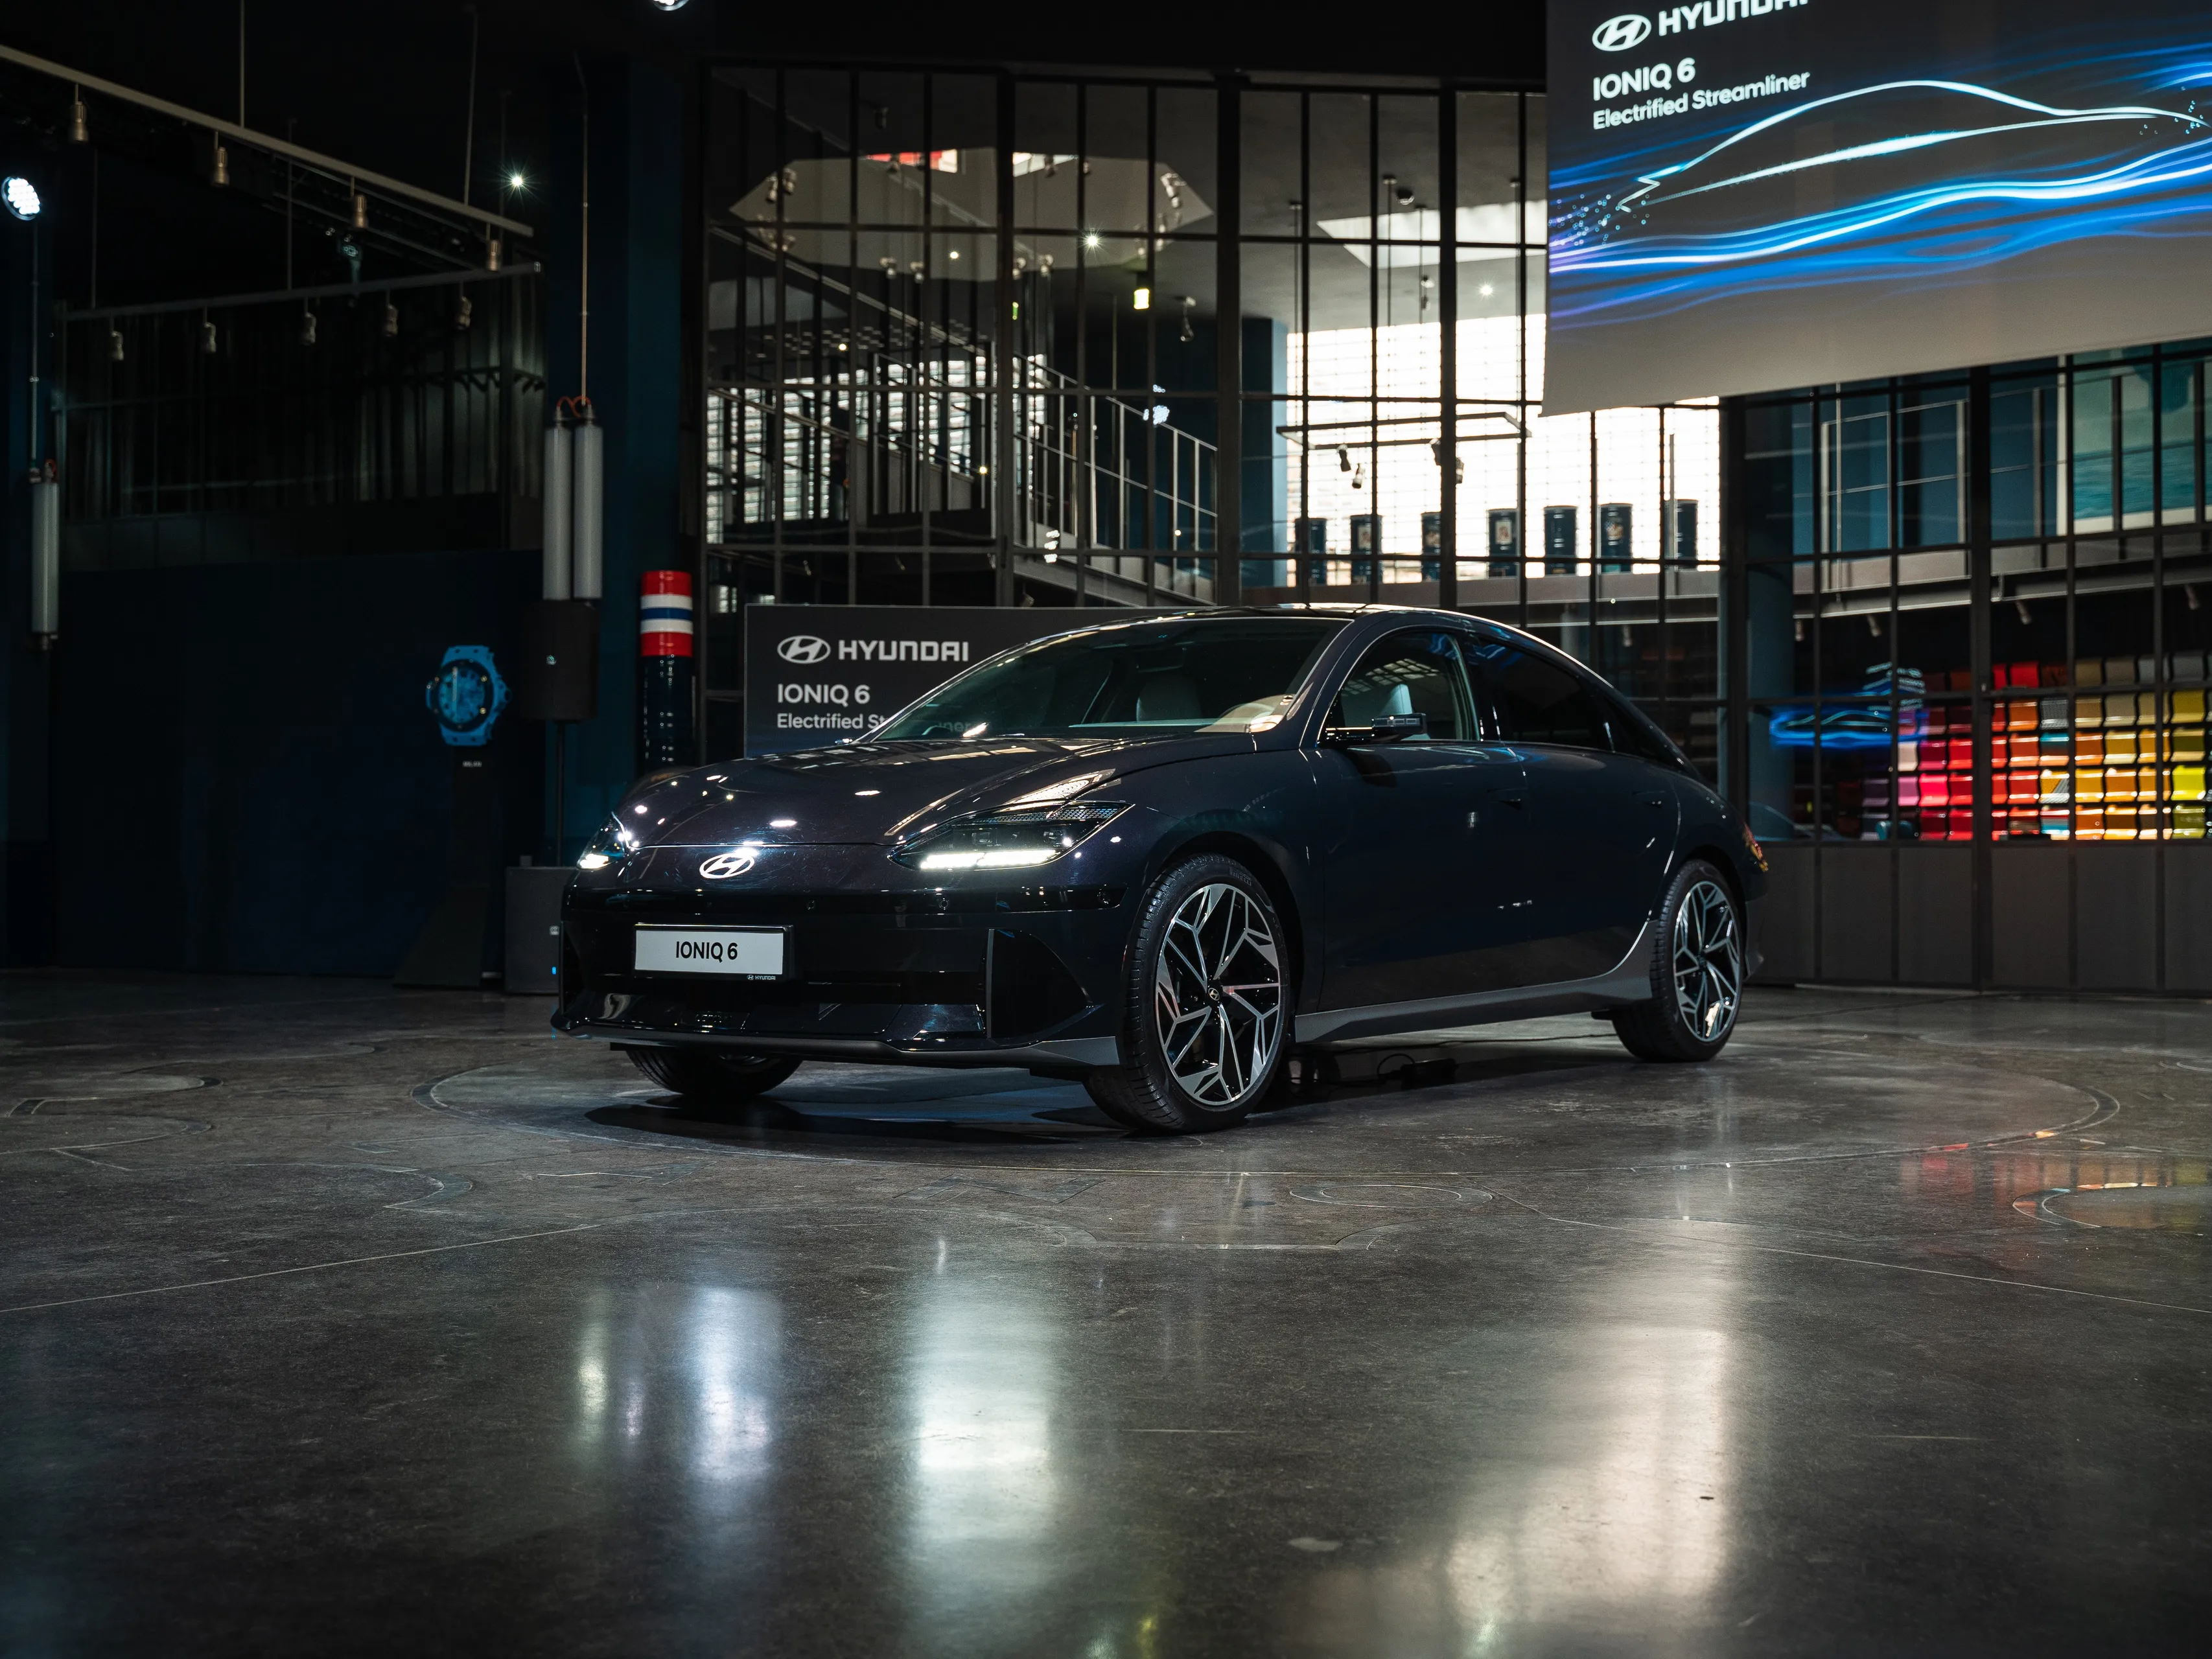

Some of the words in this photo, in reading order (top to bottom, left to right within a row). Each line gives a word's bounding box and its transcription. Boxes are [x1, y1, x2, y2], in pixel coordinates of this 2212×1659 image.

[1659, 0, 1808, 36] HYUND
[1592, 63, 1672, 100] IONIQ
[1677, 58, 1696, 82] 6
[1592, 93, 1688, 130] Electrified
[1692, 71, 1811, 110] Streamliner
[838, 640, 969, 662] HYUNDAI
[777, 684, 849, 708] IONIQ
[854, 684, 870, 704] 6
[777, 713, 863, 729] Electrified
[675, 941, 723, 963] IONIQ
[727, 942, 738, 960] 6
